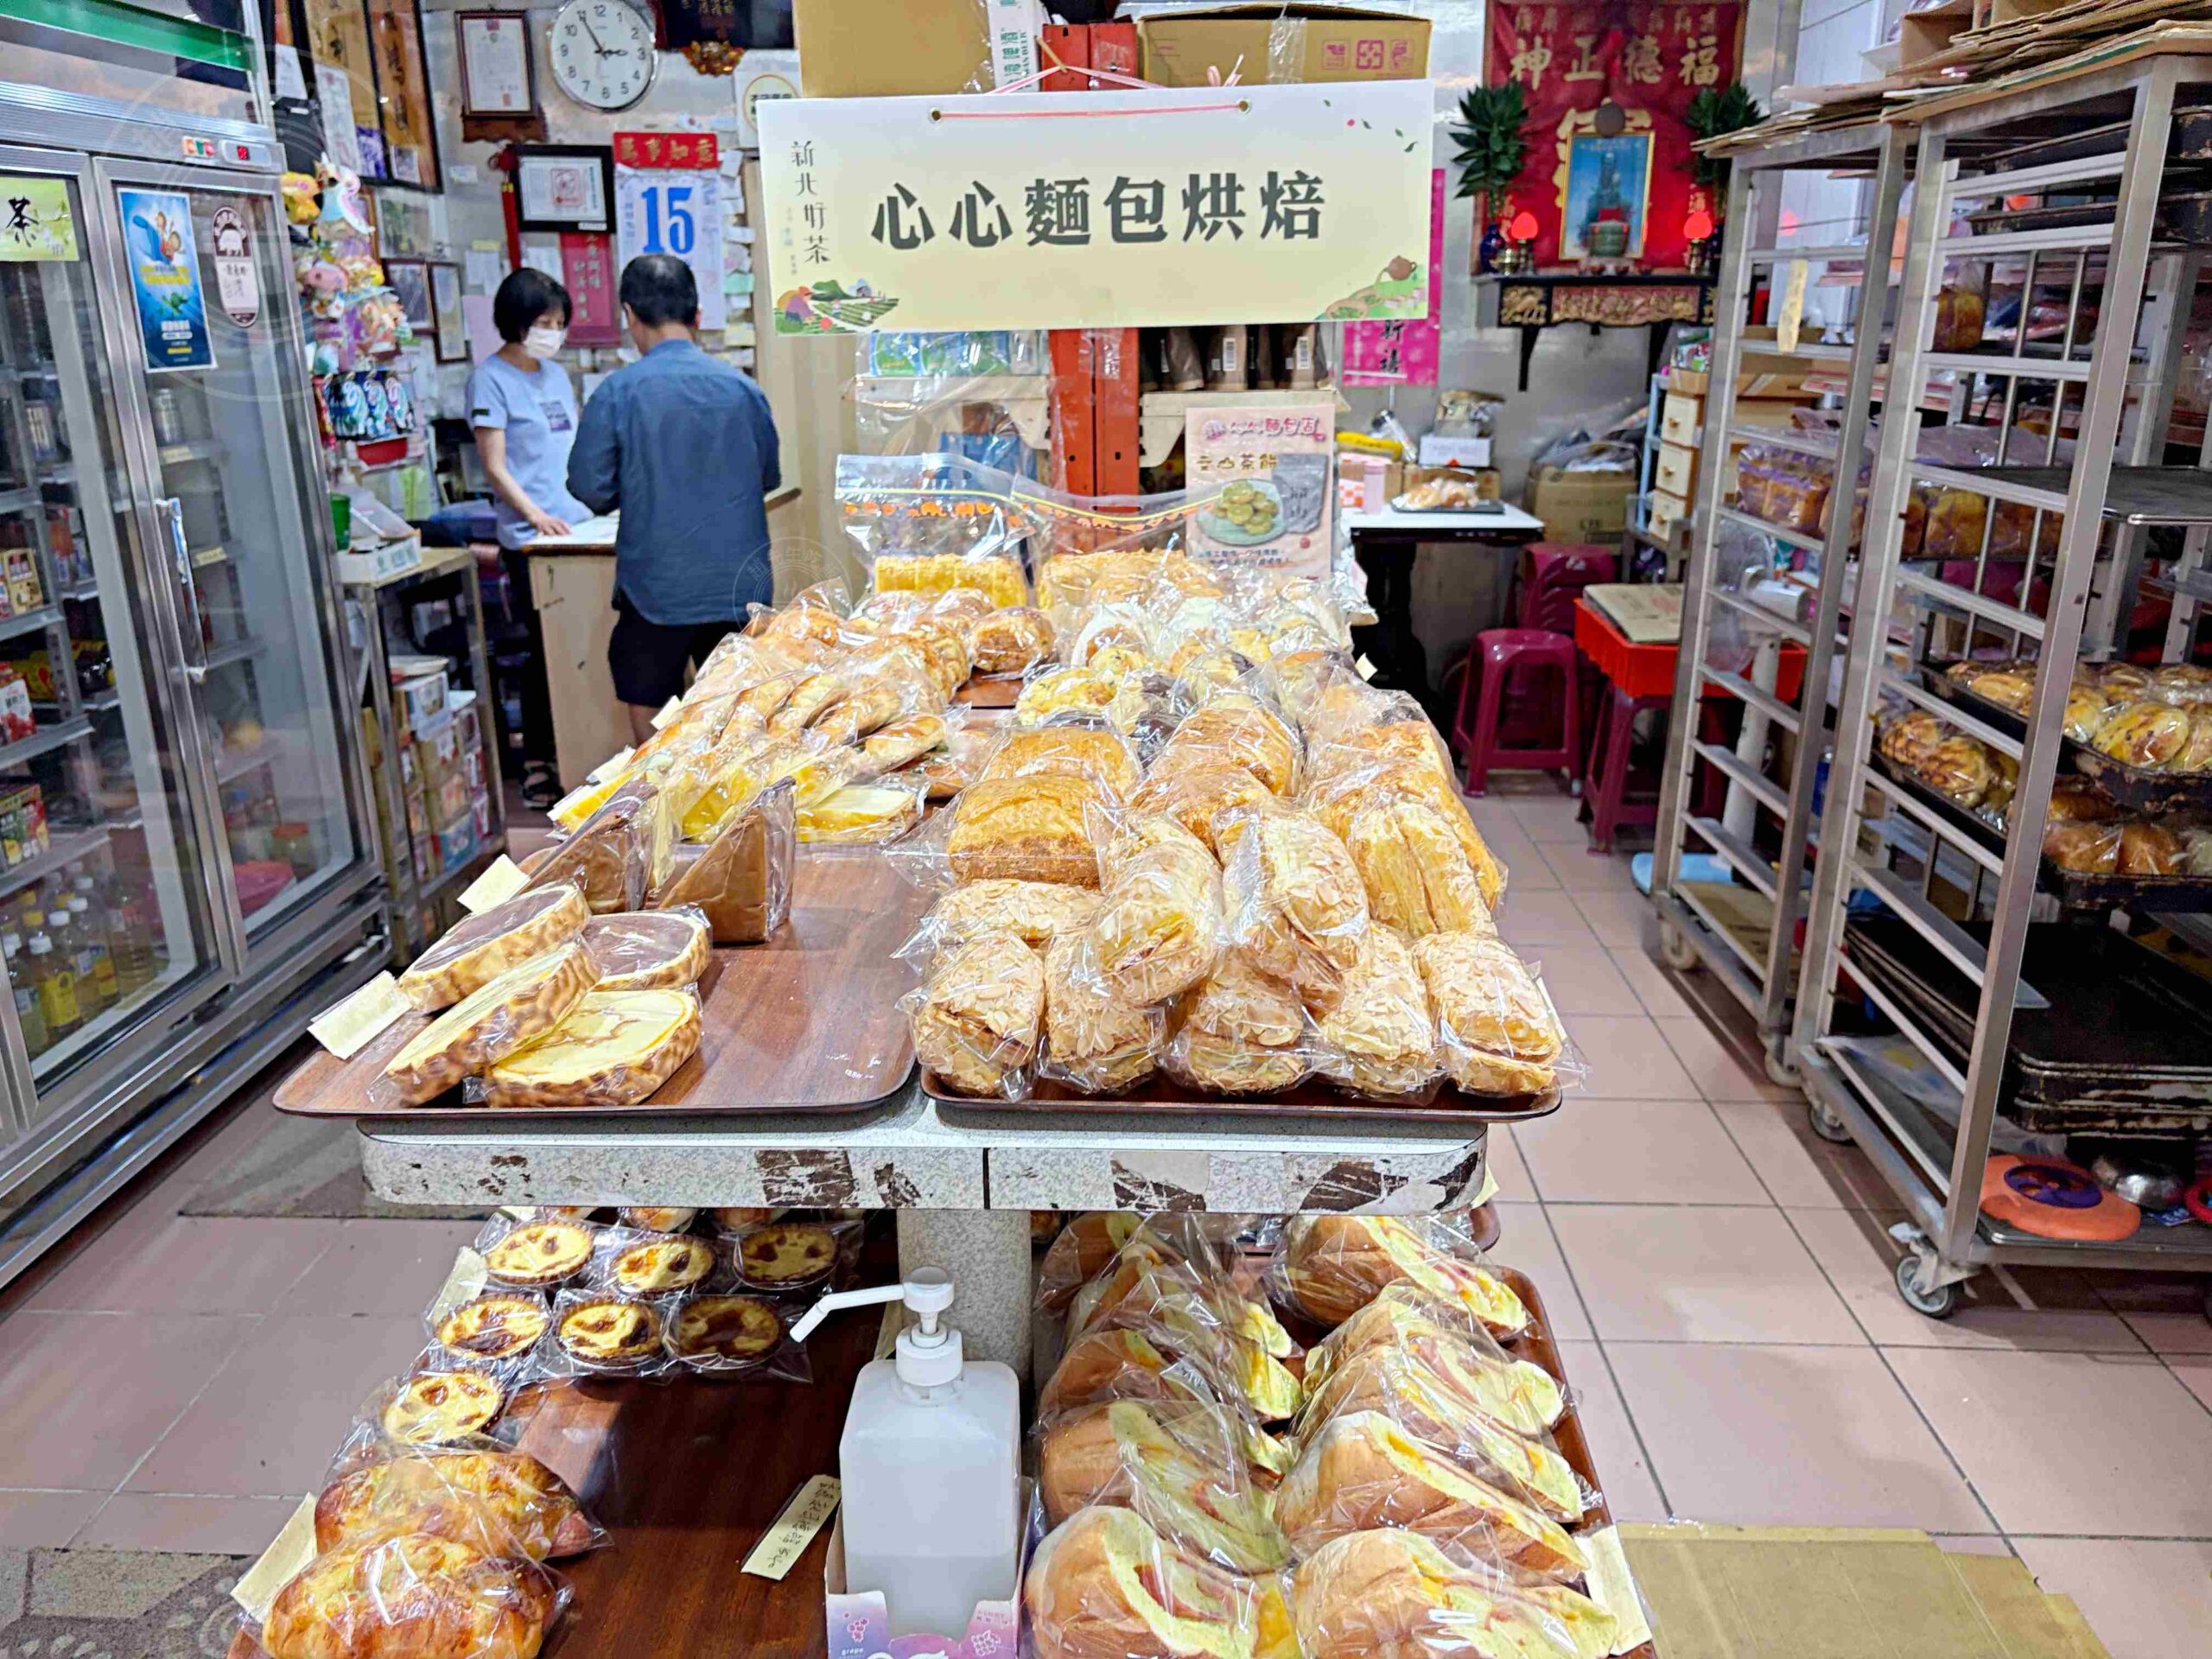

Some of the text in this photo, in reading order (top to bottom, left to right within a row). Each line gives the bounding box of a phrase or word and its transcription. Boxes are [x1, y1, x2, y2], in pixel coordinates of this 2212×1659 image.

[576, 10, 586, 22] 11
[594, 4, 606, 17] 12
[564, 24, 578, 37] 10
[631, 27, 639, 40] 2
[560, 44, 569, 57] 9
[638, 47, 646, 60] 3
[1510, 35, 1719, 90] 福德正神
[568, 66, 576, 79] 8
[632, 70, 640, 80] 4
[582, 79, 591, 92] 7
[620, 81, 629, 94] 5
[601, 86, 610, 99] 6
[791, 140, 830, 264] 新北好茶
[870, 169, 1325, 251] 心心麵包烘焙
[6, 195, 40, 248] 茶
[641, 186, 695, 254] 15
